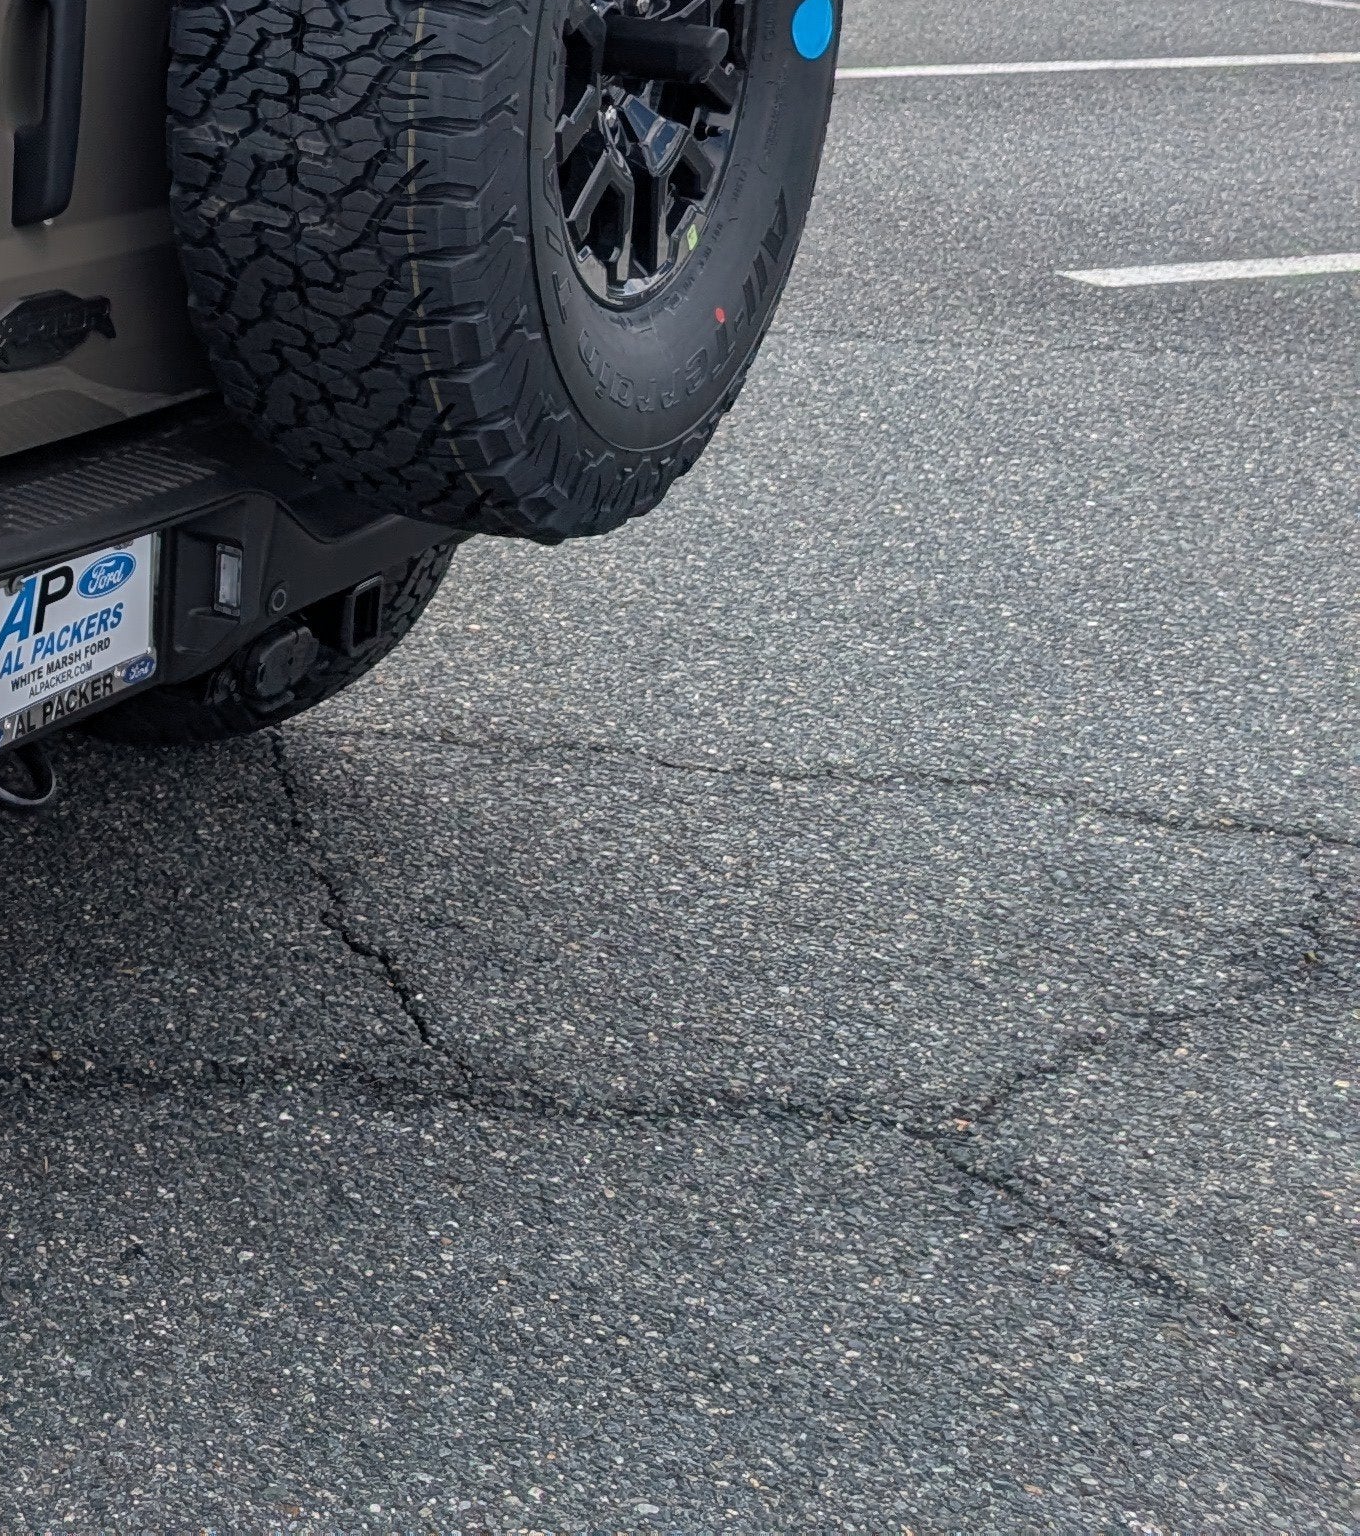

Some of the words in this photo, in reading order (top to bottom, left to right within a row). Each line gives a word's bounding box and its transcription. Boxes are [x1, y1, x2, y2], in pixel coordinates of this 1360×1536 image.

[84, 557, 130, 596] Ford
[31, 602, 124, 664] PACKERS
[10, 666, 44, 692] WHITE
[46, 649, 82, 674] MARSH
[84, 637, 111, 658] FORD
[28, 660, 93, 699] ALPACKER.COM
[12, 713, 36, 740] AL
[42, 672, 114, 725] PACKER
